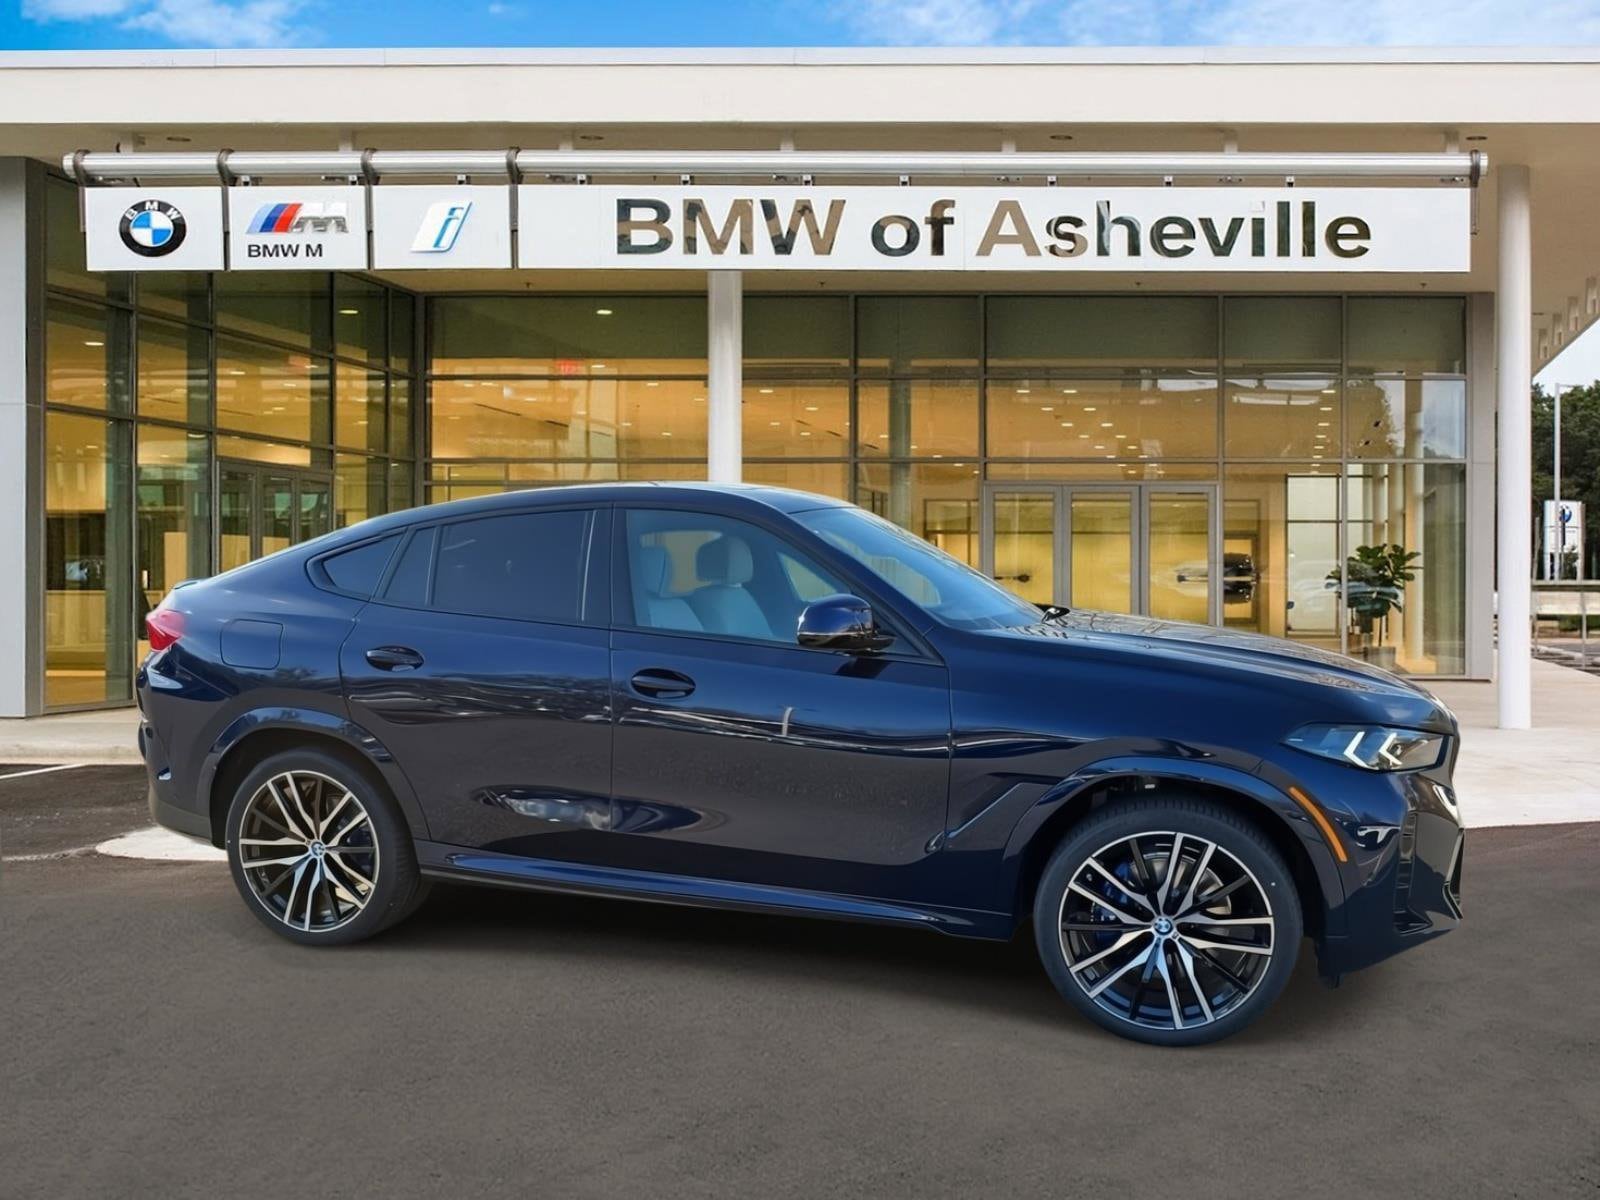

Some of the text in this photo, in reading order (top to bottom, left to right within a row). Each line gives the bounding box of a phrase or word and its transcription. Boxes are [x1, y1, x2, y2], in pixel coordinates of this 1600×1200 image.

[125, 201, 181, 220] BMW
[616, 199, 1371, 258] BMW of Asheville
[247, 244, 323, 258] BMW M
